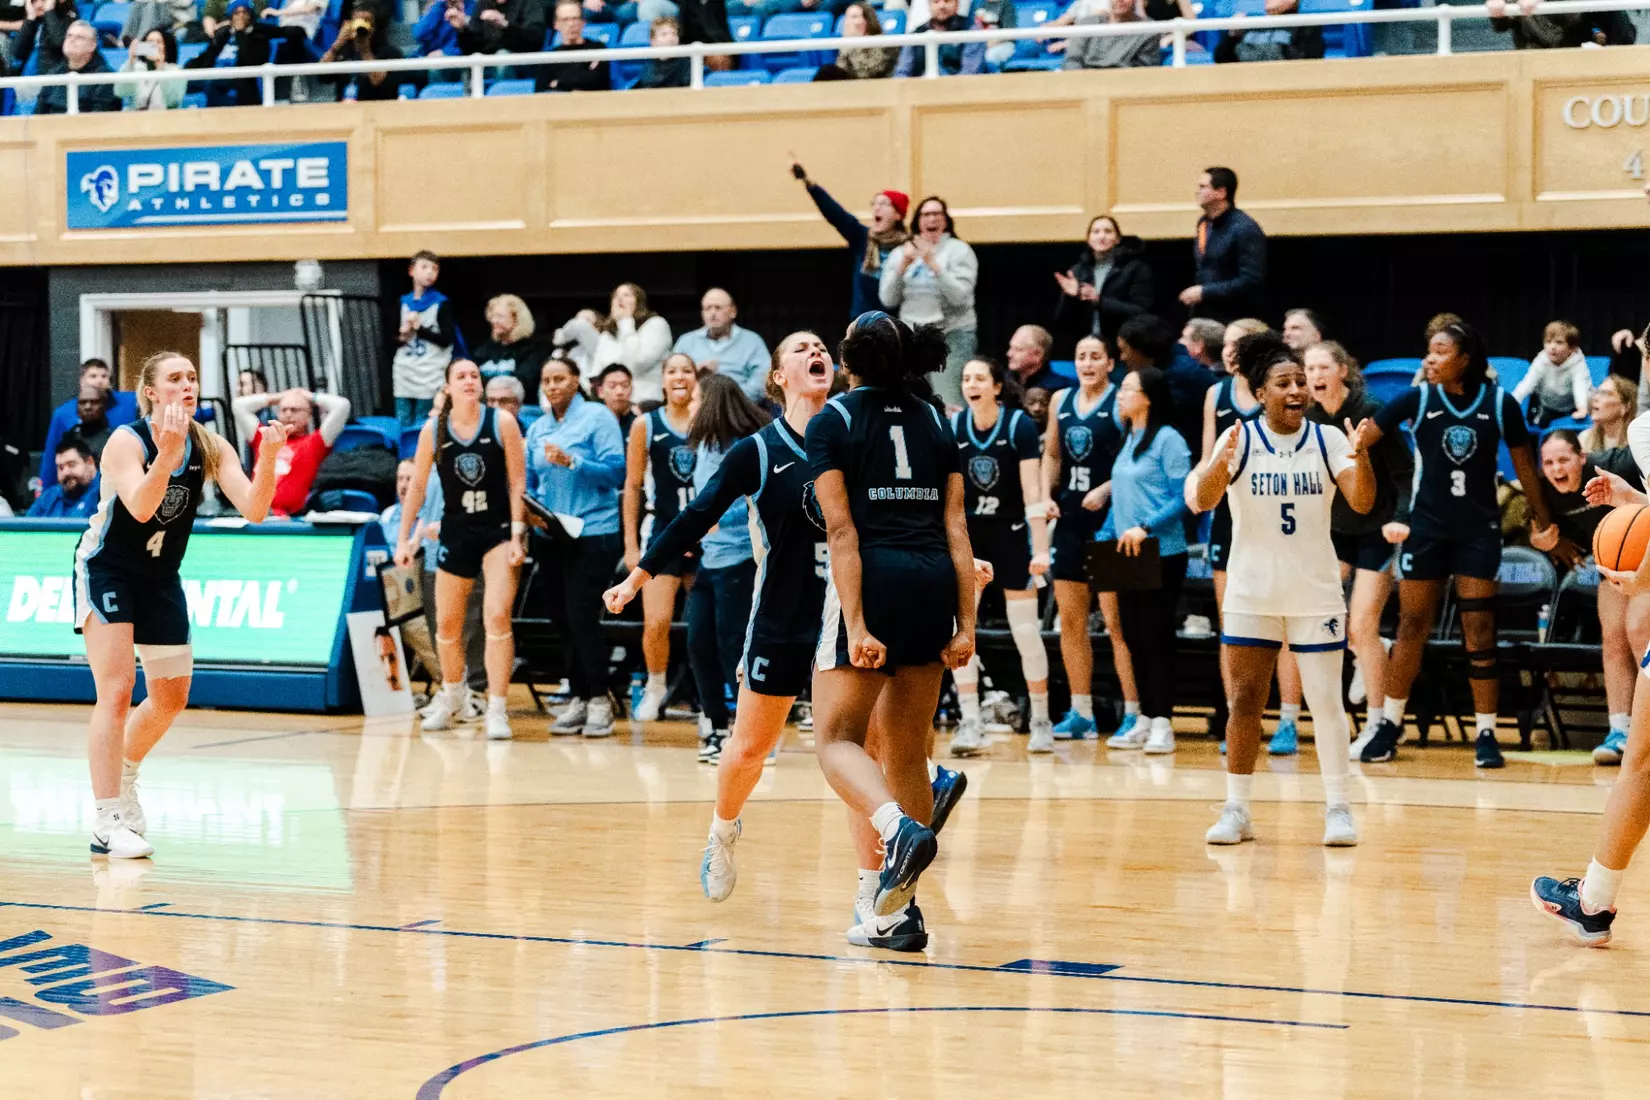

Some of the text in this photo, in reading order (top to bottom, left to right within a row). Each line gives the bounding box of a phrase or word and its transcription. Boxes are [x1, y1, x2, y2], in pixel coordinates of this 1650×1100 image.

[127, 157, 330, 193] PIRATE
[127, 192, 331, 211] ATHLETICS
[889, 425, 912, 479] 1
[1068, 466, 1091, 491] 15
[1251, 471, 1323, 496] SETON HALL
[1450, 470, 1466, 496] 3
[462, 490, 488, 513] 42
[868, 487, 939, 501] COLUMBIA
[974, 495, 1000, 515] 12
[1281, 502, 1296, 535] 5
[146, 530, 167, 557] 4
[7, 575, 285, 628] DEL NTAL
[102, 591, 119, 613] C
[751, 656, 769, 682] C
